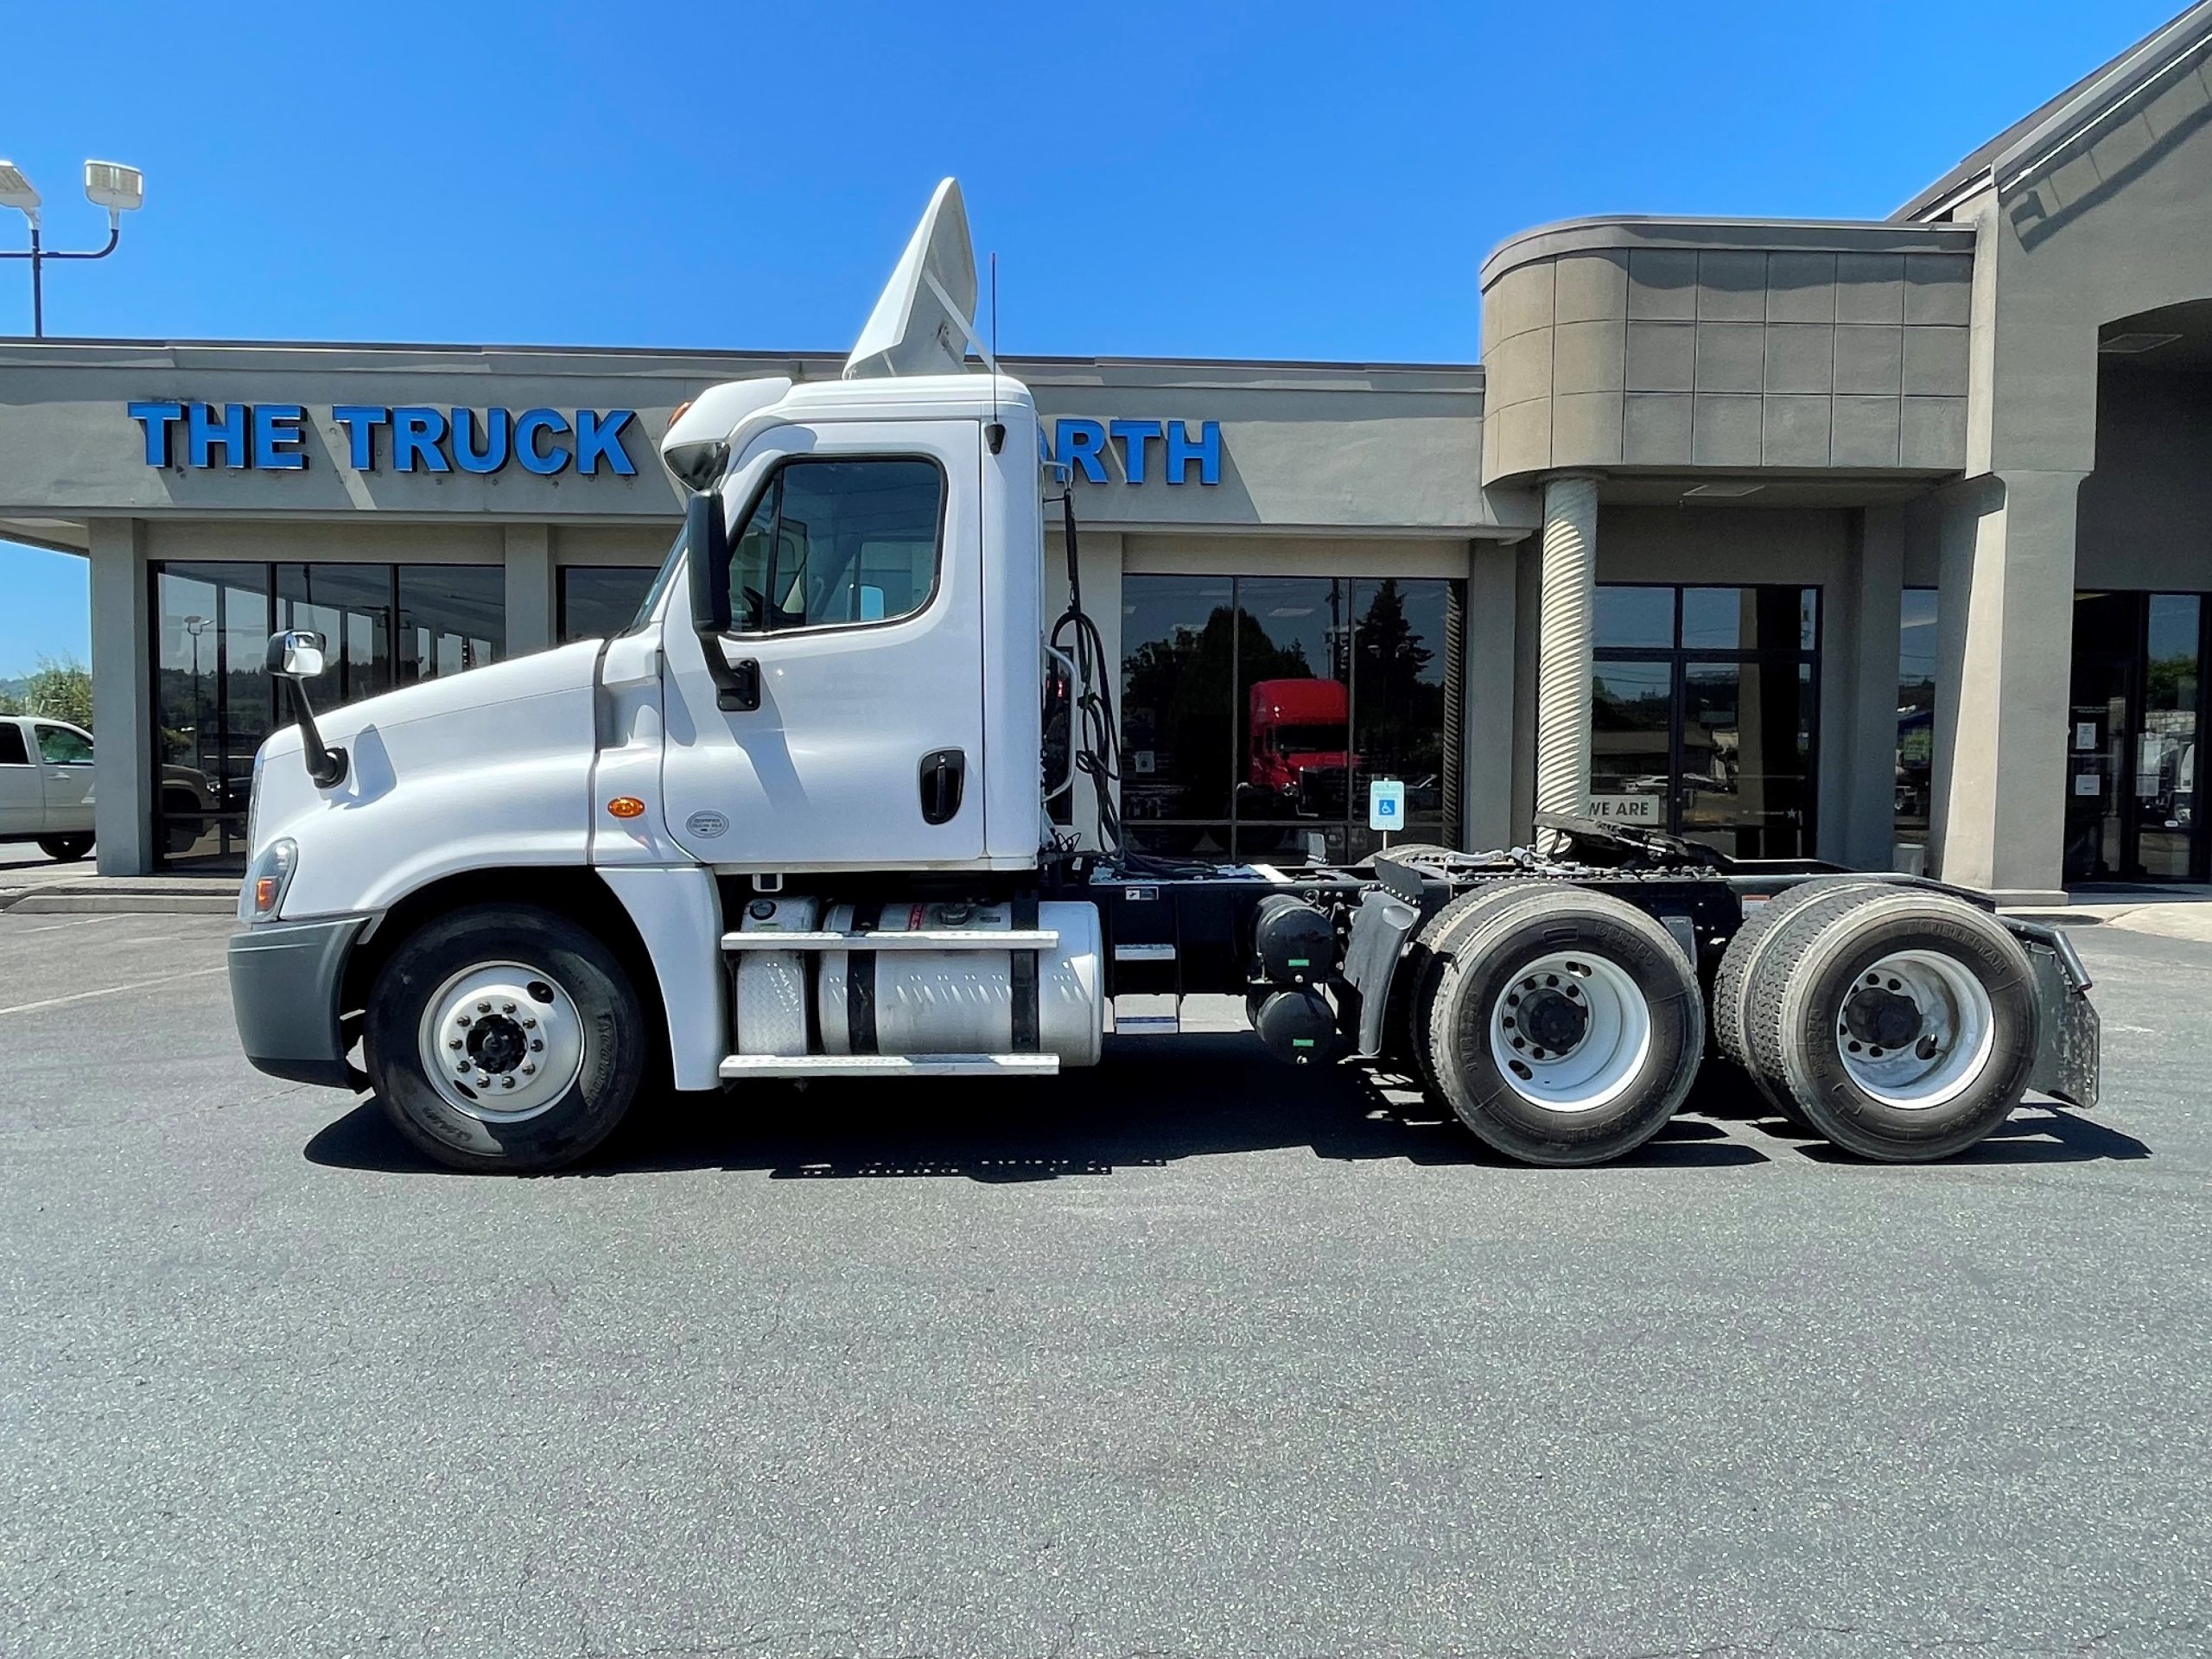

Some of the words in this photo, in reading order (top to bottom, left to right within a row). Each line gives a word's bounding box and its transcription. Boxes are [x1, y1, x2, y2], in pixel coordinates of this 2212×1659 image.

[128, 401, 308, 471] THE
[332, 404, 637, 475] TRUCK
[1039, 419, 1221, 486] RTH
[1616, 802, 1649, 816] ARE
